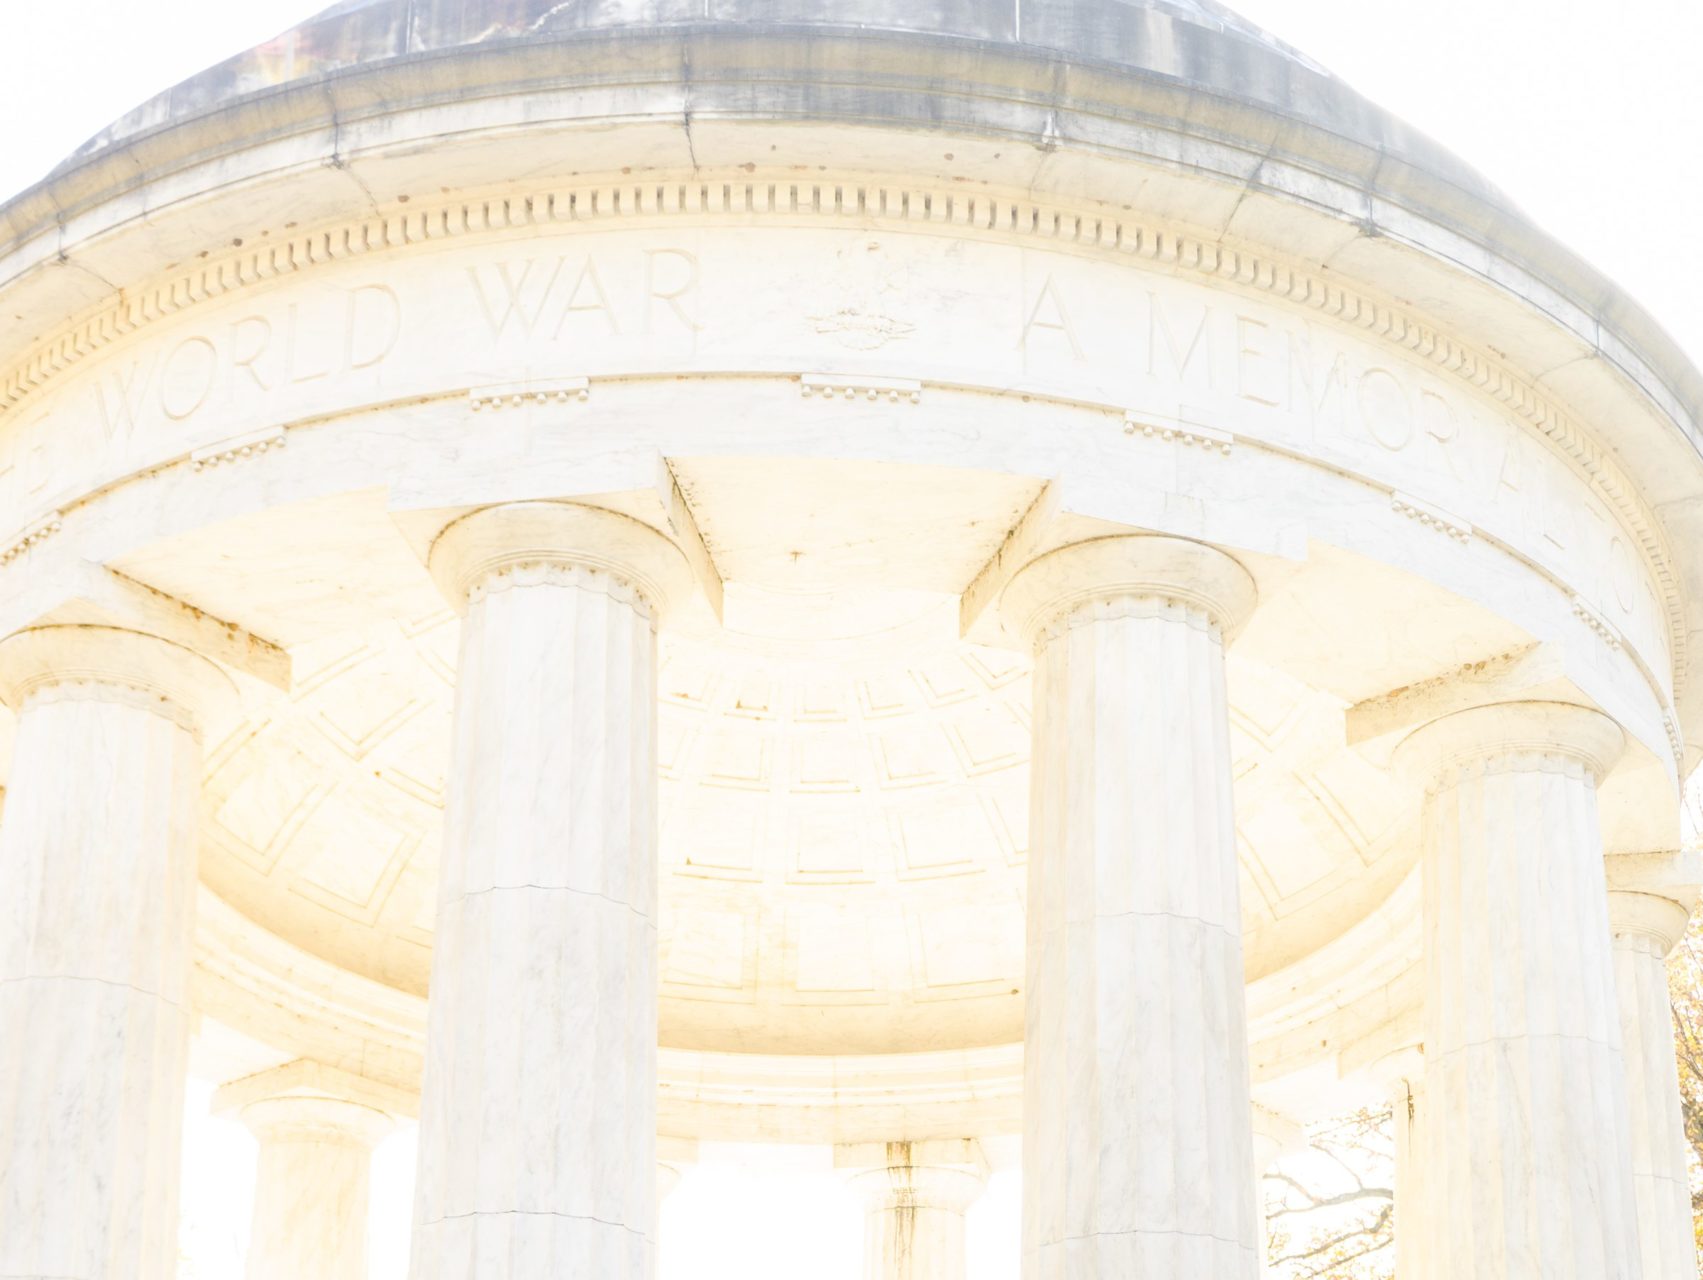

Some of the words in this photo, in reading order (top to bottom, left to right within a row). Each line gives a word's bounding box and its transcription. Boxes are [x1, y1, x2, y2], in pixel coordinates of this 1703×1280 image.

[92, 283, 403, 447] WORLD
[465, 248, 704, 342] WAR
[1014, 270, 1087, 362] A
